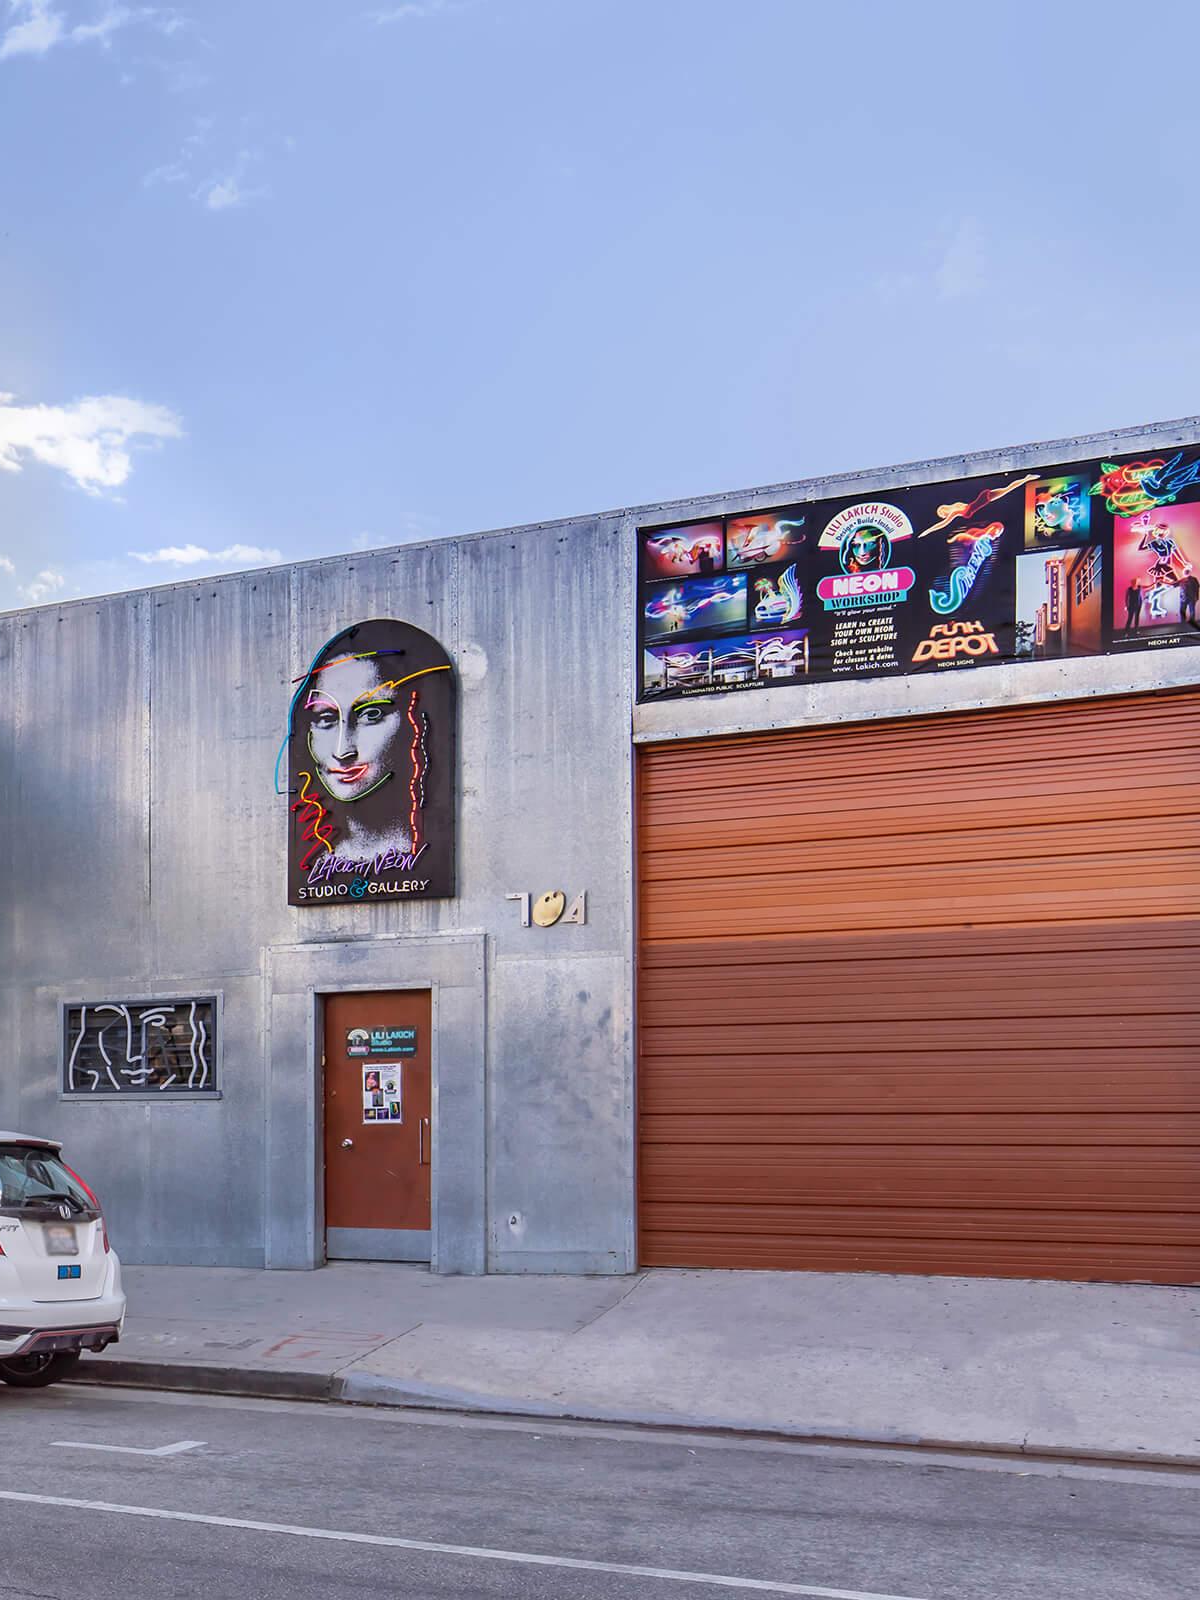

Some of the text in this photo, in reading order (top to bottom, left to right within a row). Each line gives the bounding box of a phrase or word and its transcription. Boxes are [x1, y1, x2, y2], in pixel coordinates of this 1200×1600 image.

[825, 505, 904, 536] LILI LAKICH Studio
[832, 572, 898, 596] NEON
[831, 592, 900, 608] WORKSHOP
[836, 621, 858, 630] LEARN
[868, 617, 893, 626] CREATE
[830, 638, 848, 646] SIGN
[859, 632, 898, 644] SCULPTURE
[834, 625, 894, 638] YOUR OWN NEON
[835, 649, 853, 658] Check
[868, 645, 894, 654] website
[912, 633, 1000, 662] DEPOT
[956, 658, 974, 666] SIGNS
[298, 878, 430, 898] STUDIO & GALLERY
